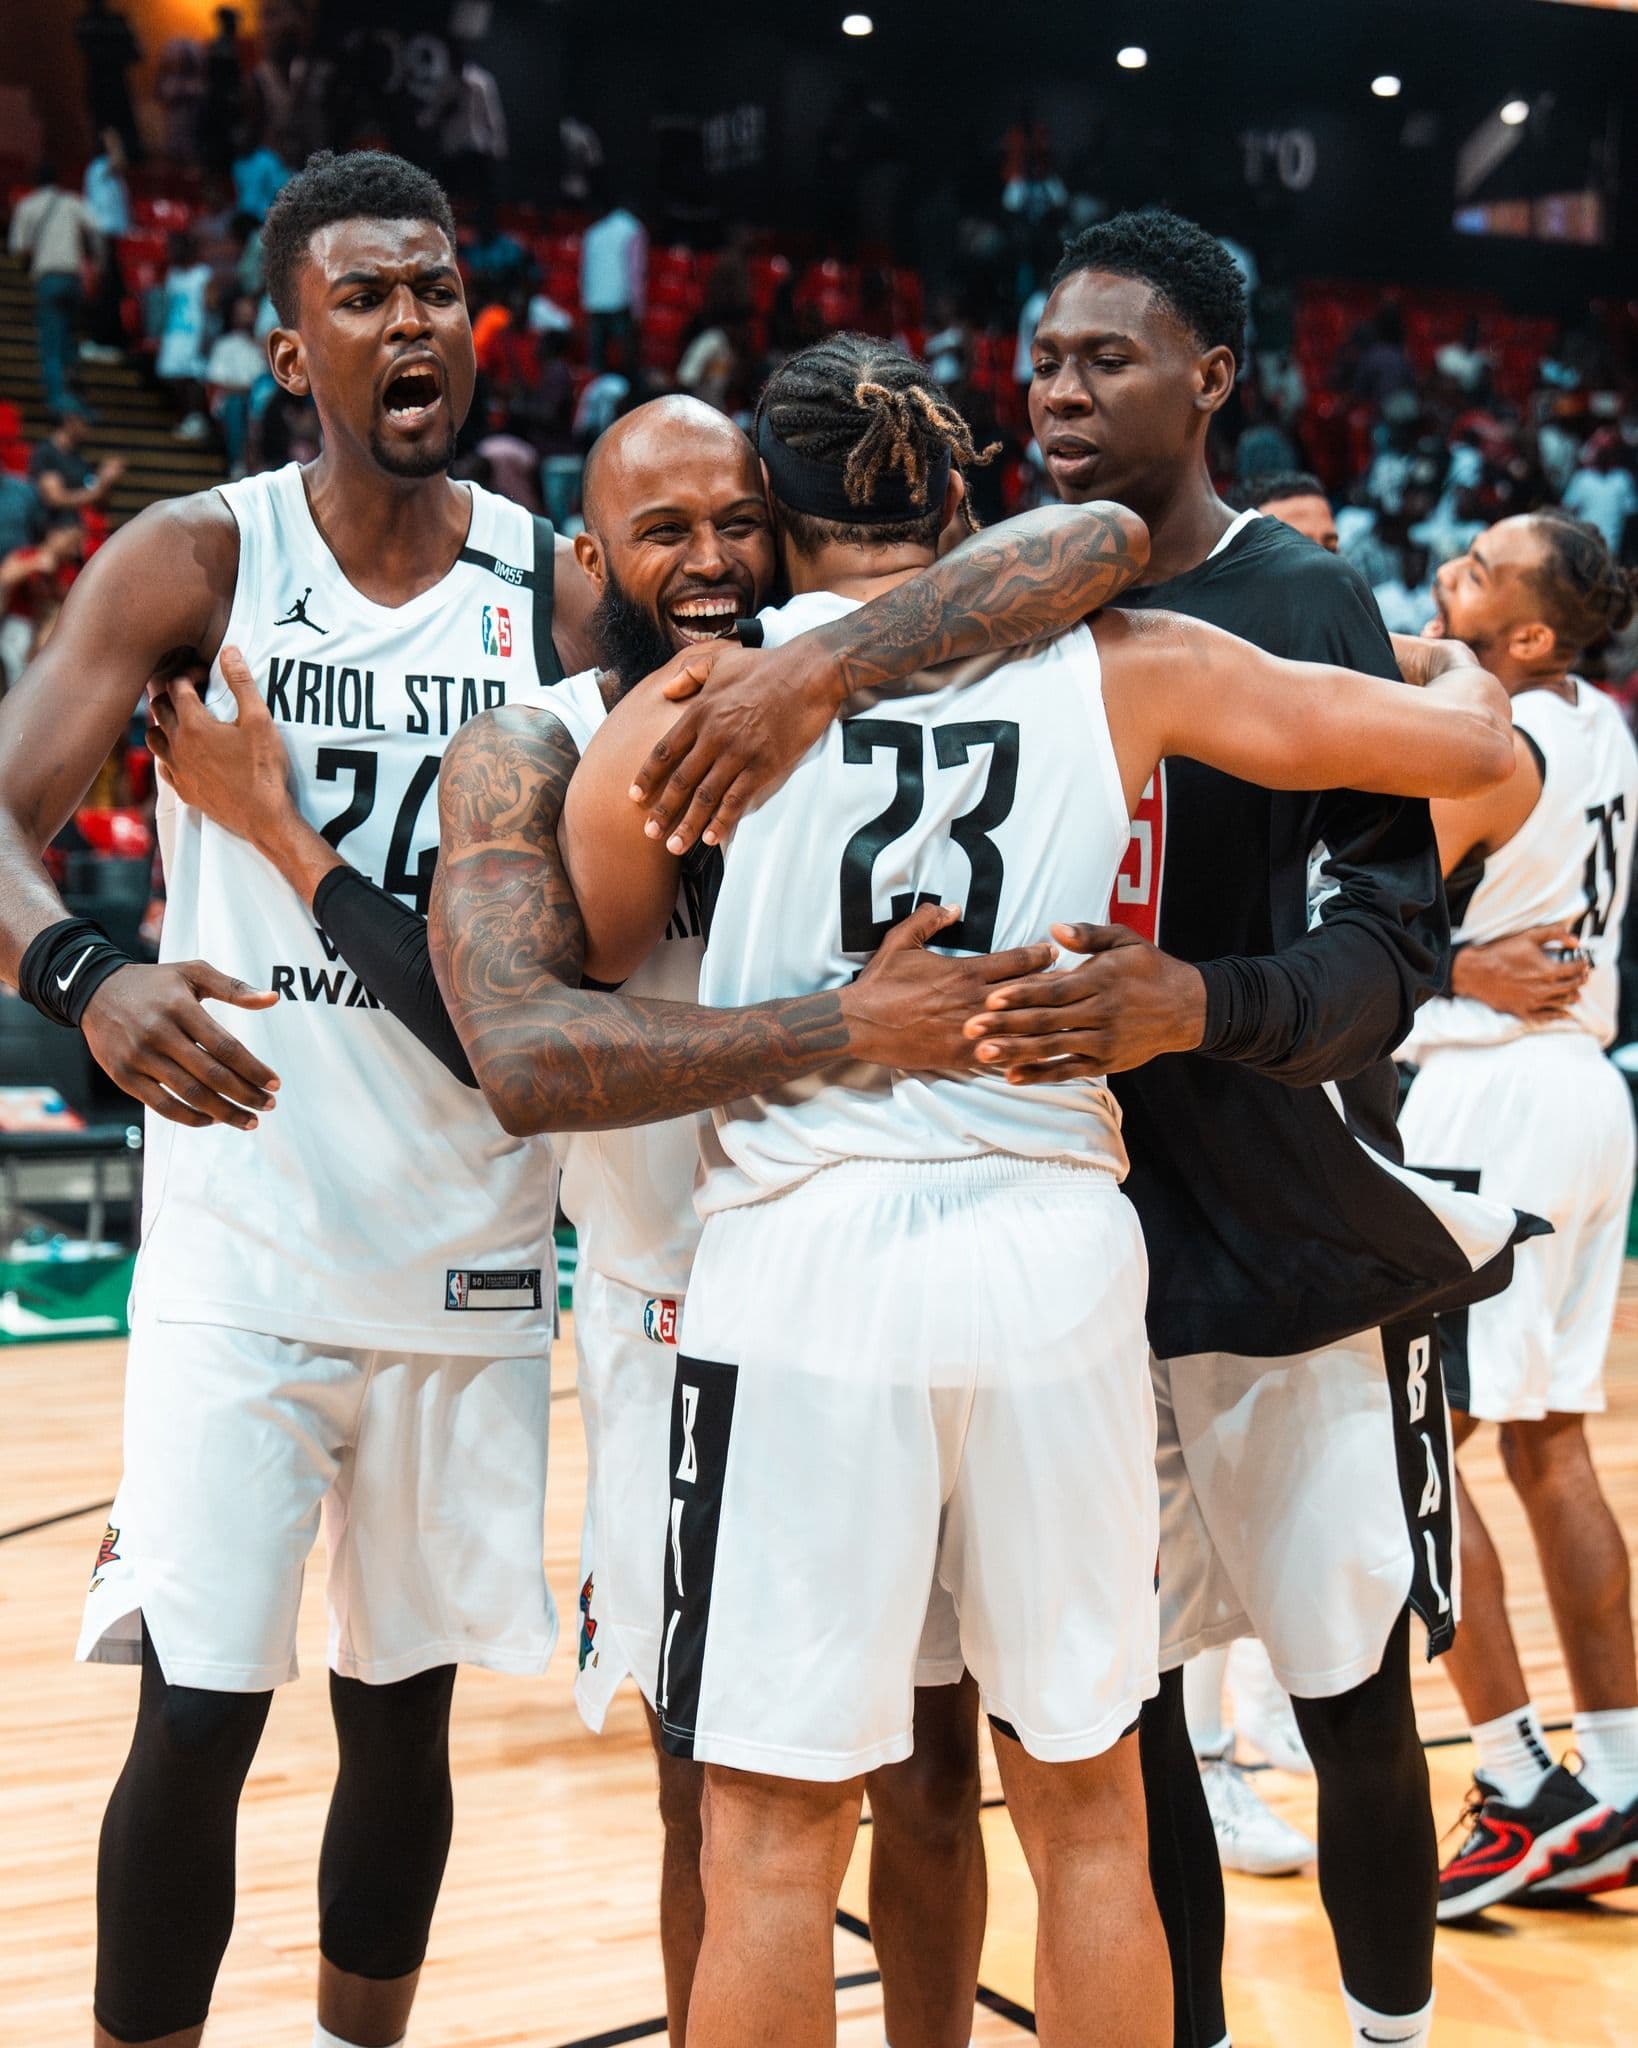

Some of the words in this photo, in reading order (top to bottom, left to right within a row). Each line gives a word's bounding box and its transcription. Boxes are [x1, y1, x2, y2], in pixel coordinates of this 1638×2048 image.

[267, 657, 386, 731] KRIOL
[840, 718, 1020, 953] 23
[268, 965, 389, 1010] RWA
